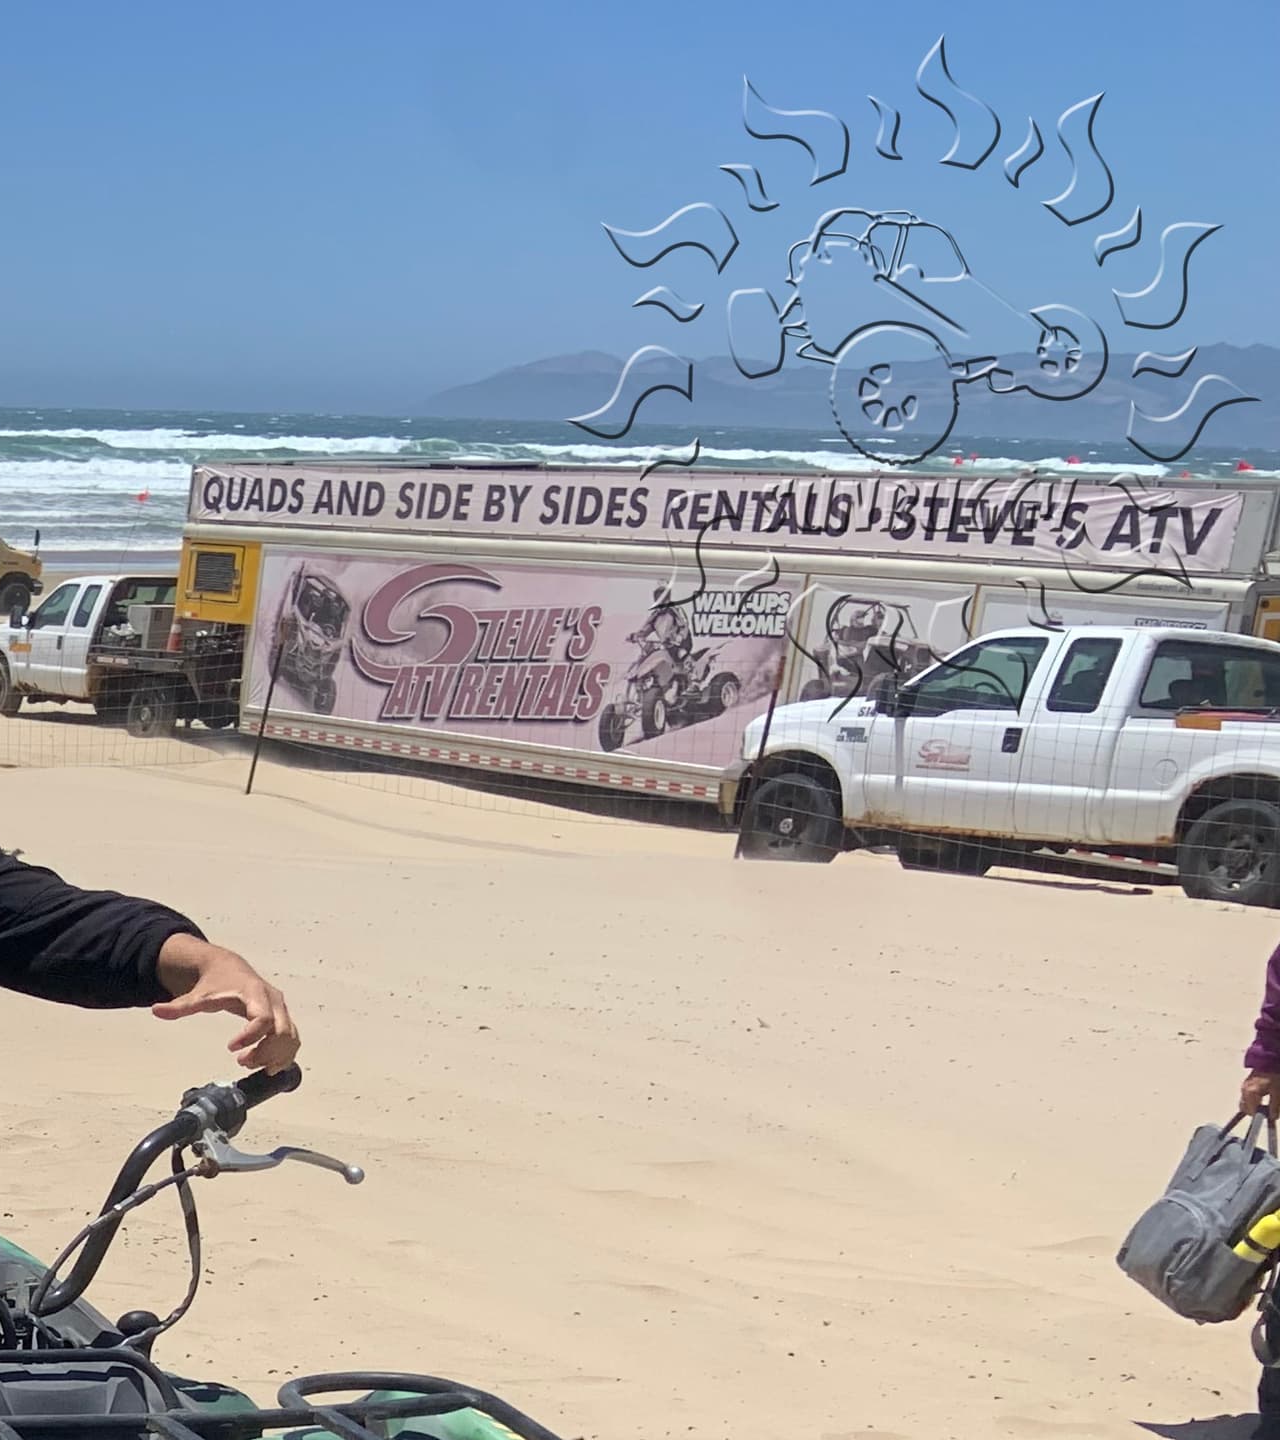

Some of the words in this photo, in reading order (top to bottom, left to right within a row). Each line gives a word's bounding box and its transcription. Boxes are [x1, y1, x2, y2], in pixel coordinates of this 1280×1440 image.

[202, 476, 306, 514] QUADS
[312, 479, 386, 517] AND
[395, 481, 474, 520] SIDE
[482, 484, 533, 523] BY
[539, 485, 649, 529] SIDES
[661, 489, 852, 537] RENTALS
[889, 494, 1089, 550] STEVE'S
[1101, 504, 1223, 556] ATV
[692, 611, 789, 637] WELCOME
[382, 663, 461, 719] ATV
[450, 663, 611, 721] RENTALS
